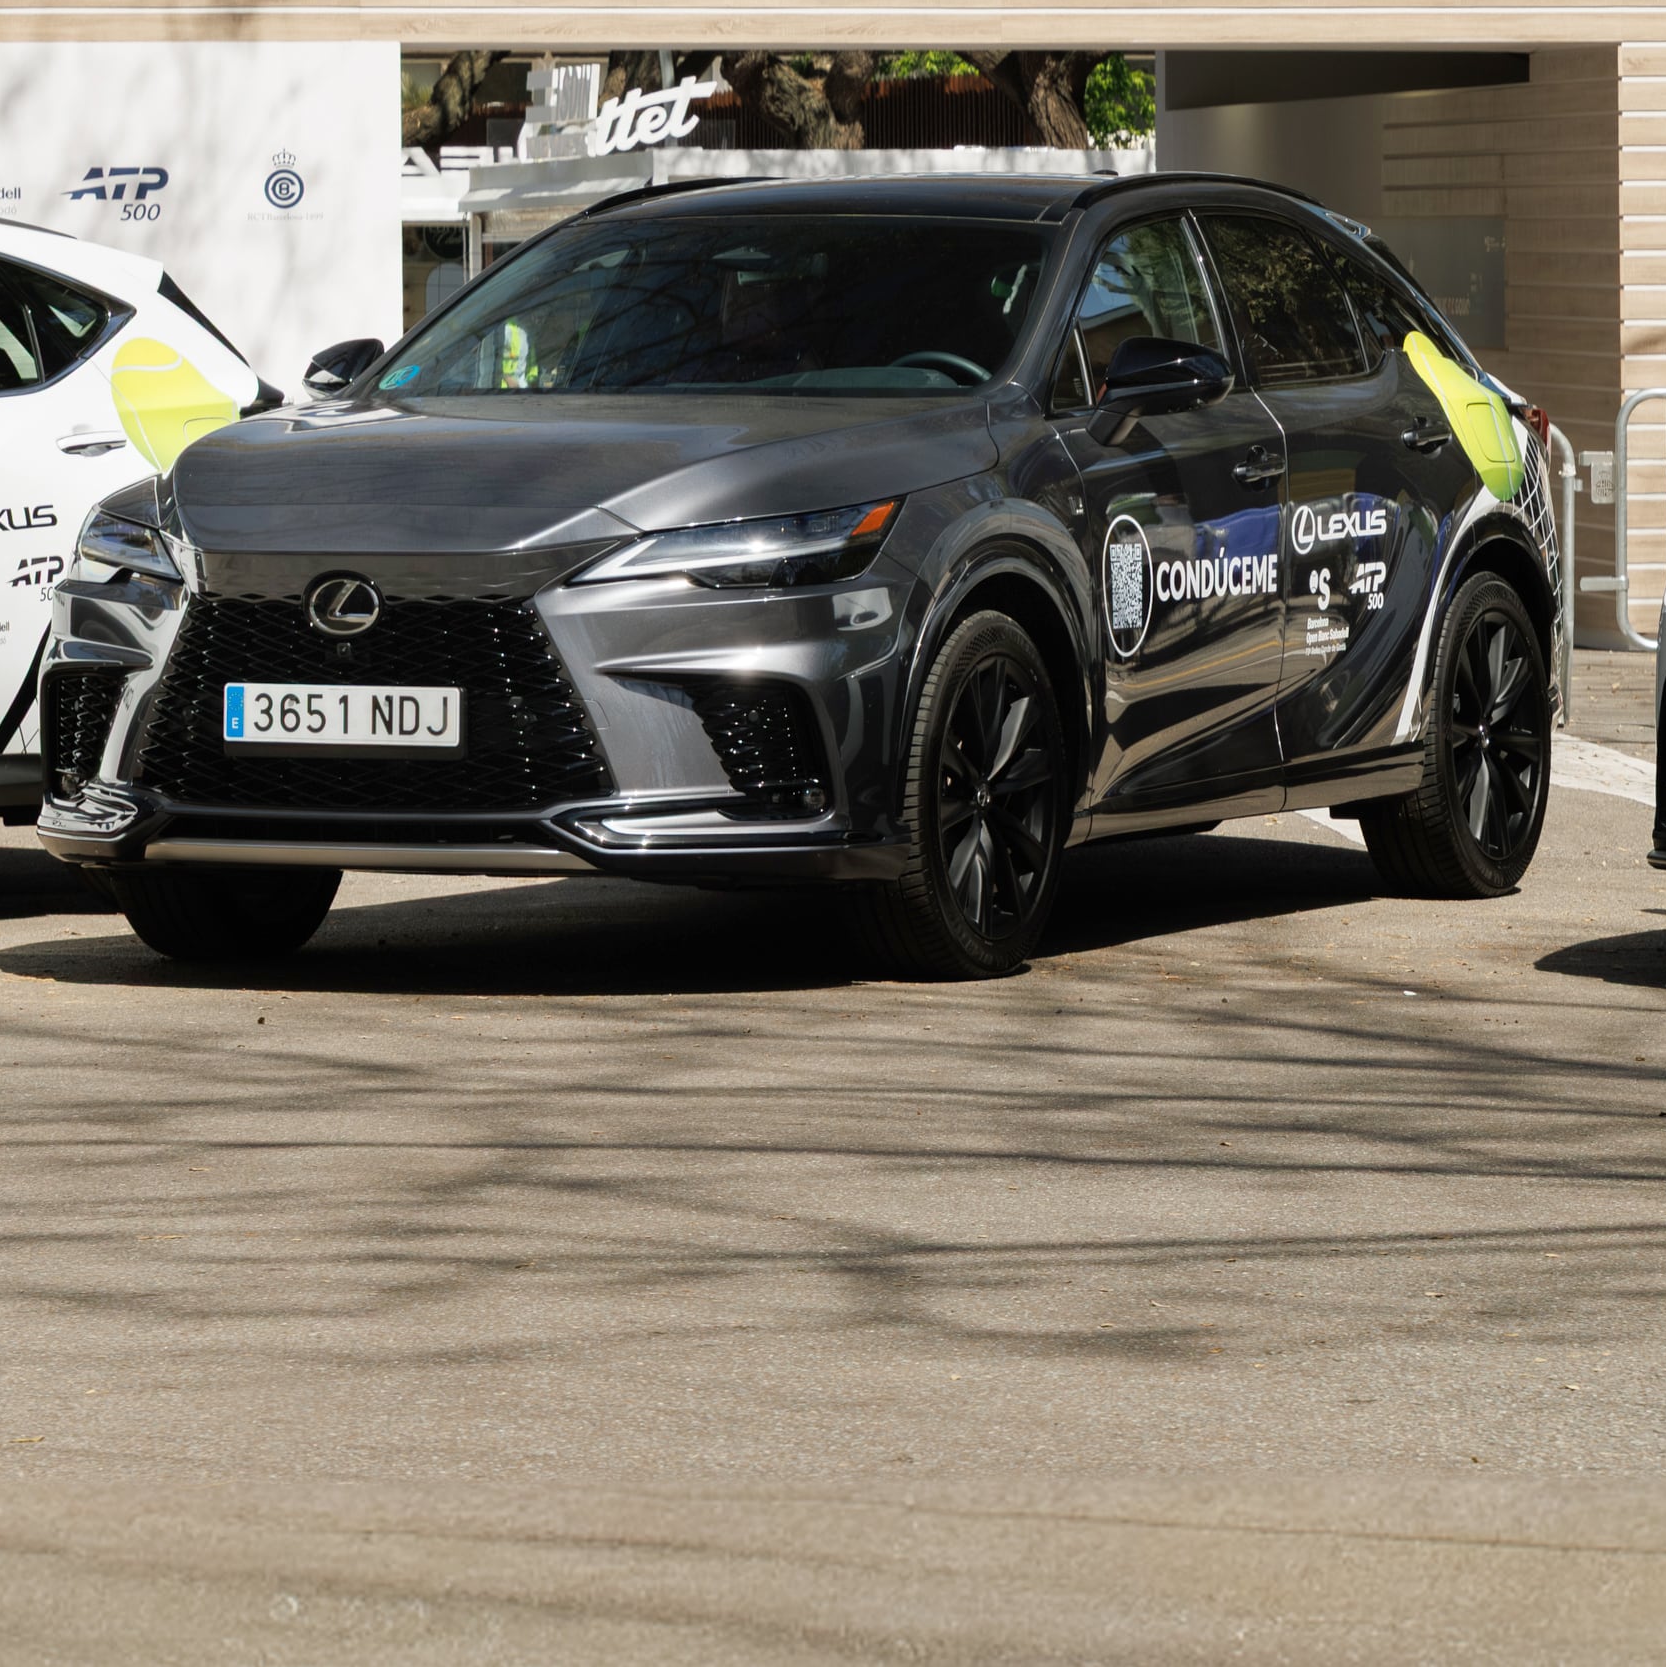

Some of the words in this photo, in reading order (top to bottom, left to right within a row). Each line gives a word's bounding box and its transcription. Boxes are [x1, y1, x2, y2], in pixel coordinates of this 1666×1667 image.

[61, 167, 169, 200] ATP
[120, 204, 161, 221] 500
[1317, 509, 1386, 541] LEXUS
[6, 556, 64, 587] ATP
[1156, 547, 1278, 602] CONDÚCEME
[1348, 561, 1387, 595] ATP
[1367, 592, 1384, 610] 500
[231, 717, 239, 729] E
[253, 692, 349, 734] 3651
[370, 694, 448, 736] NDJ
